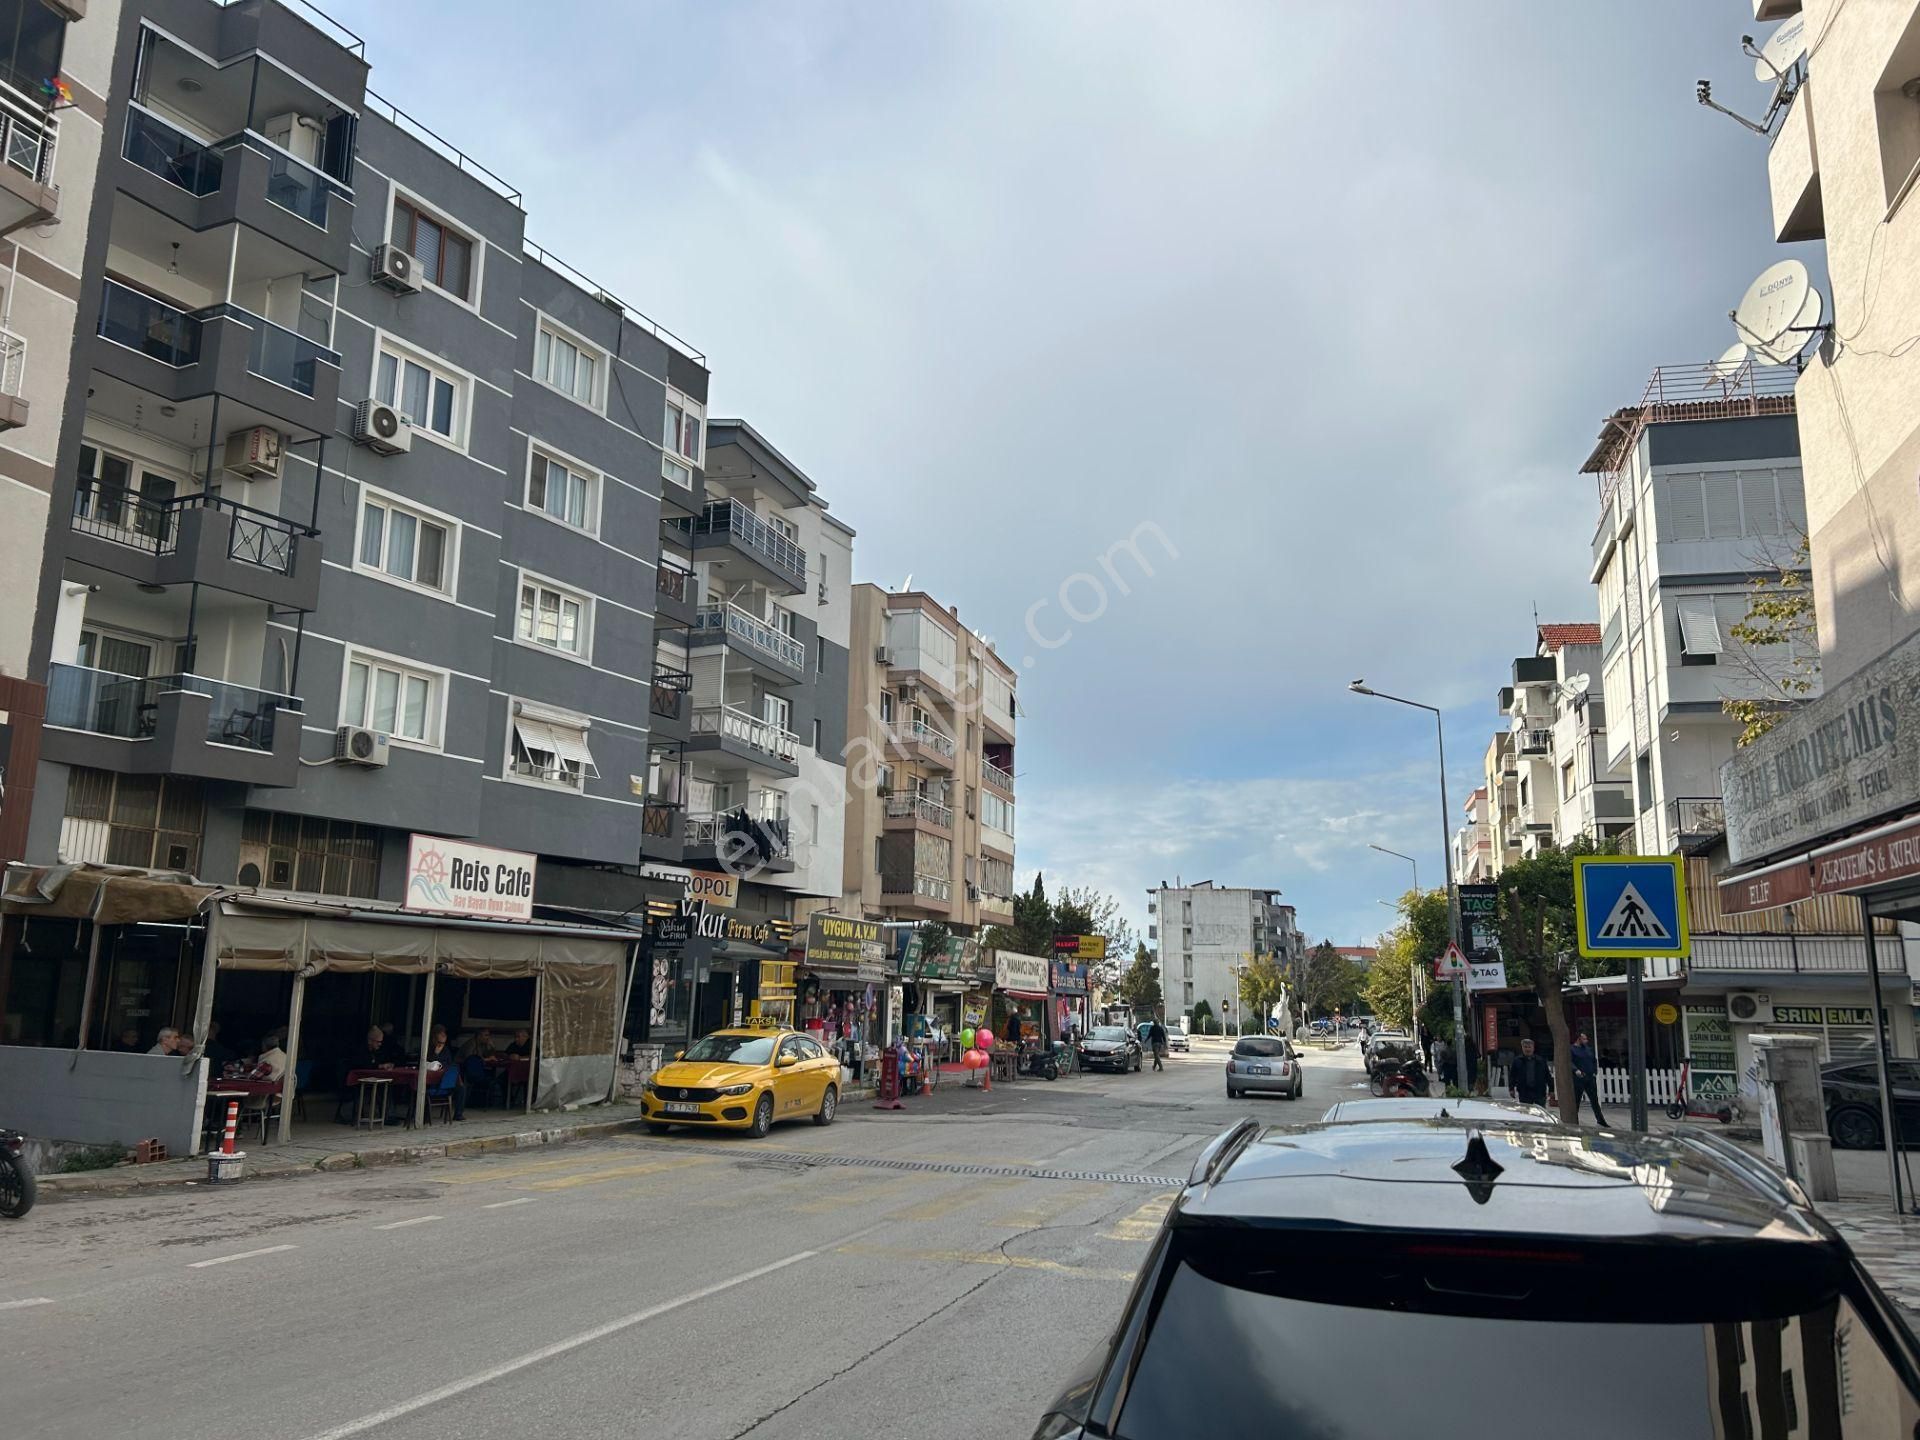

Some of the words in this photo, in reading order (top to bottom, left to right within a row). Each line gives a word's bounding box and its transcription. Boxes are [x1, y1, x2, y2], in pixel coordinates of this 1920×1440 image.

[450, 857, 490, 893] Reis
[495, 864, 531, 898] Cafe
[1749, 882, 1770, 904] ELİF
[1464, 899, 1494, 911] TAG
[754, 923, 769, 944] Cafe
[823, 918, 854, 938] UYGUN
[1479, 968, 1499, 976] TAG
[1773, 1008, 1822, 1024] SRIN
[1828, 1008, 1875, 1024] EMLA
